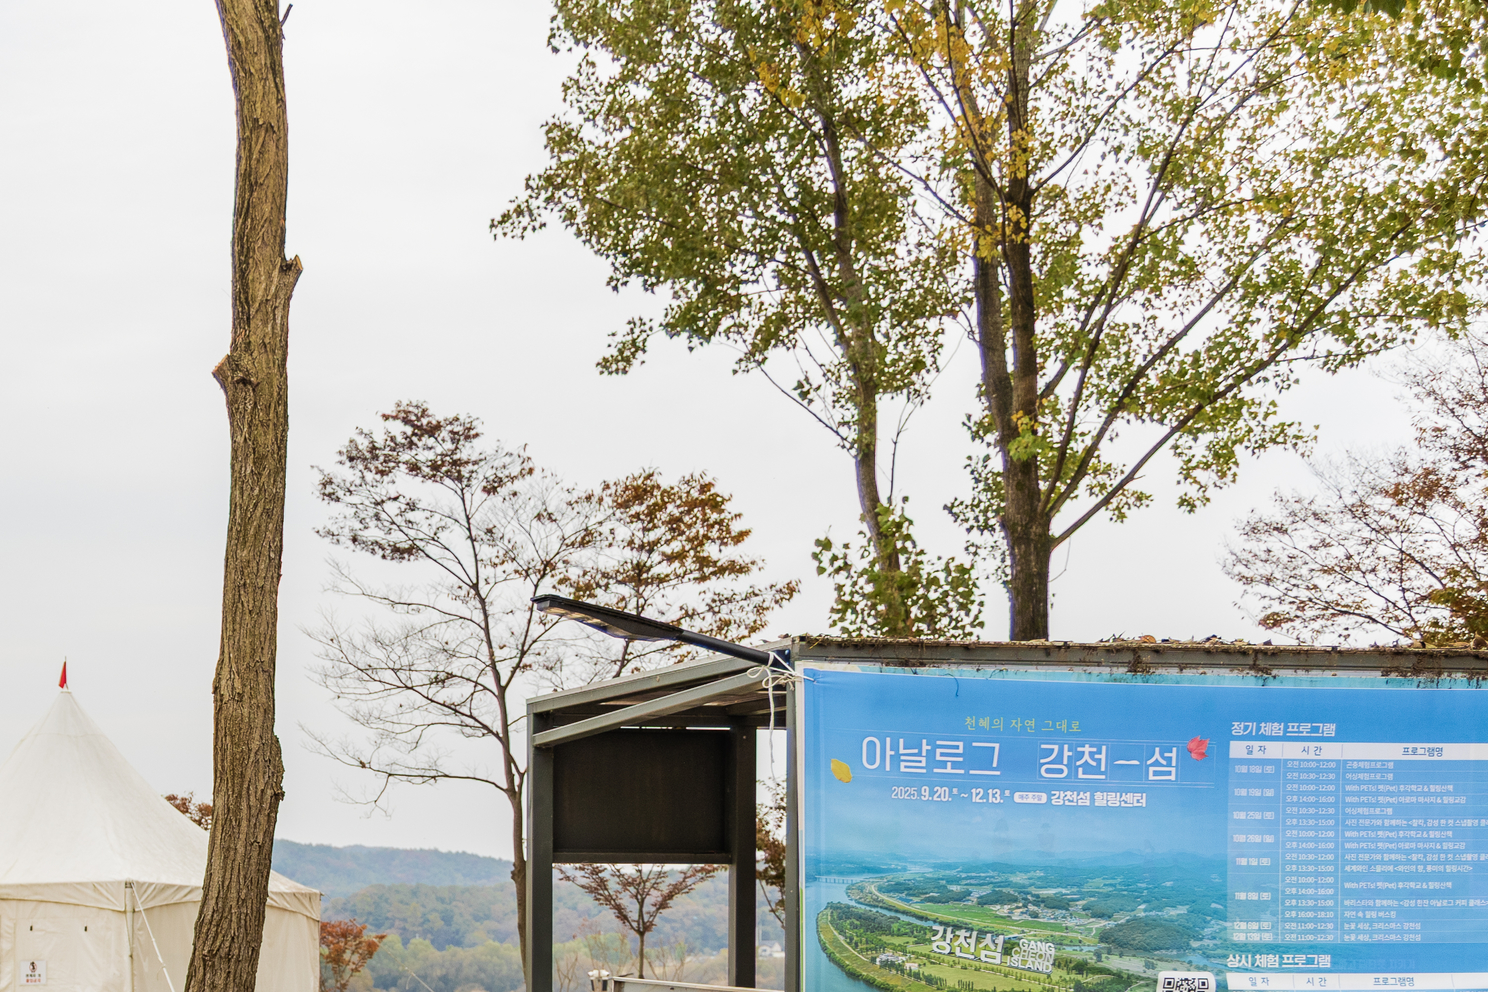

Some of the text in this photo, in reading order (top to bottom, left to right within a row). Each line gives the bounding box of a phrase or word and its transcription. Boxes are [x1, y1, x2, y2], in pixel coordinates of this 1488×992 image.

[965, 716, 1082, 733] 천혜의 자연 그대로
[1231, 722, 1336, 737] 정기 체험 프로그램
[862, 736, 1001, 775] 아날로그
[1402, 747, 1443, 757] 프로그램명
[1051, 791, 1090, 805] 강천섬
[1094, 792, 1146, 807] 힐링센터
[931, 925, 1005, 965] 강천섬
[1019, 939, 1055, 952] GANG
[1012, 947, 1055, 964] CHEON
[1227, 954, 1331, 968] 상시 체험 프로그램
[1007, 956, 1052, 973] ISLAND
[1373, 977, 1415, 987] 프로그램명
